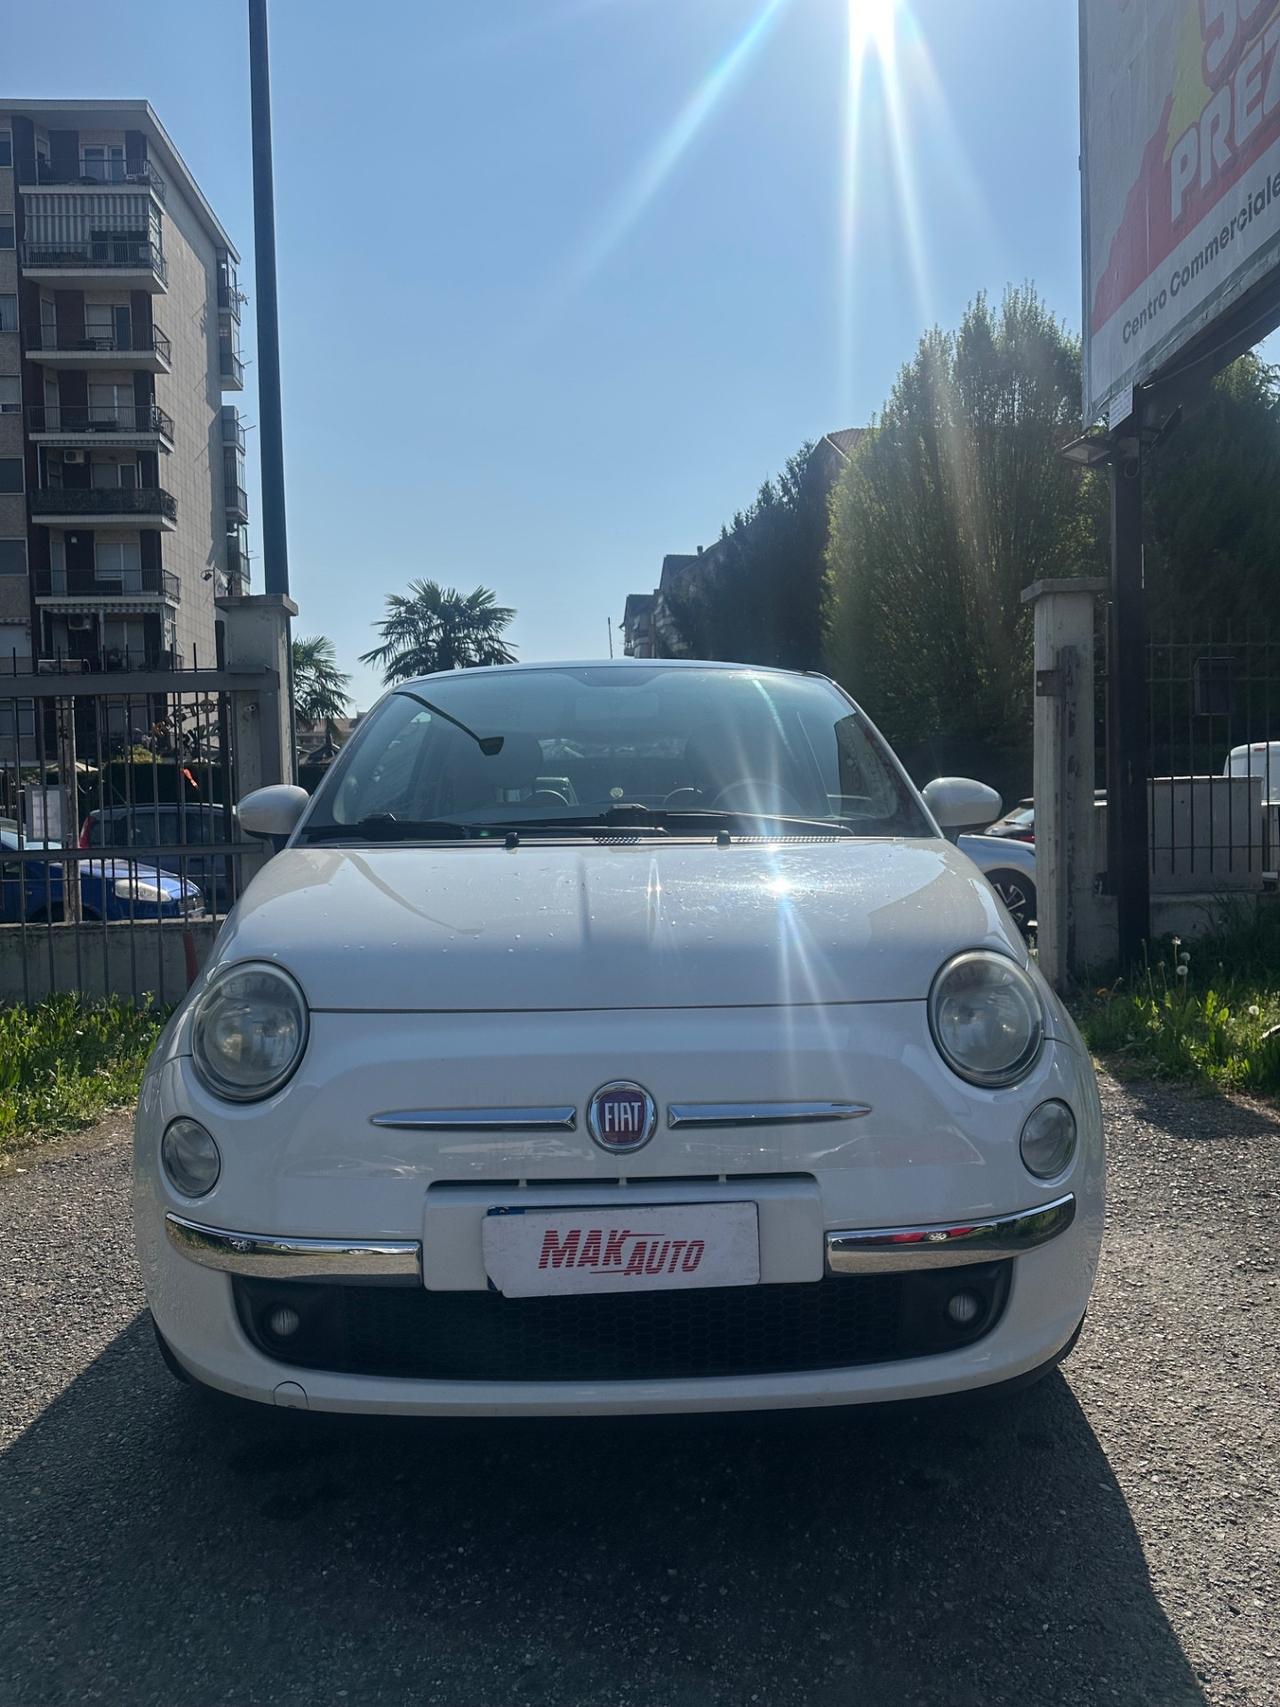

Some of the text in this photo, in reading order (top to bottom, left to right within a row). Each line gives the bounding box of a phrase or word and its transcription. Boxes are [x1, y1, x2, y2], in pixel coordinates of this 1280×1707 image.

[1122, 172, 1280, 345] Centro Commerciale
[604, 1101, 642, 1132] FIAT
[538, 1229, 705, 1276] MAK AUTO
